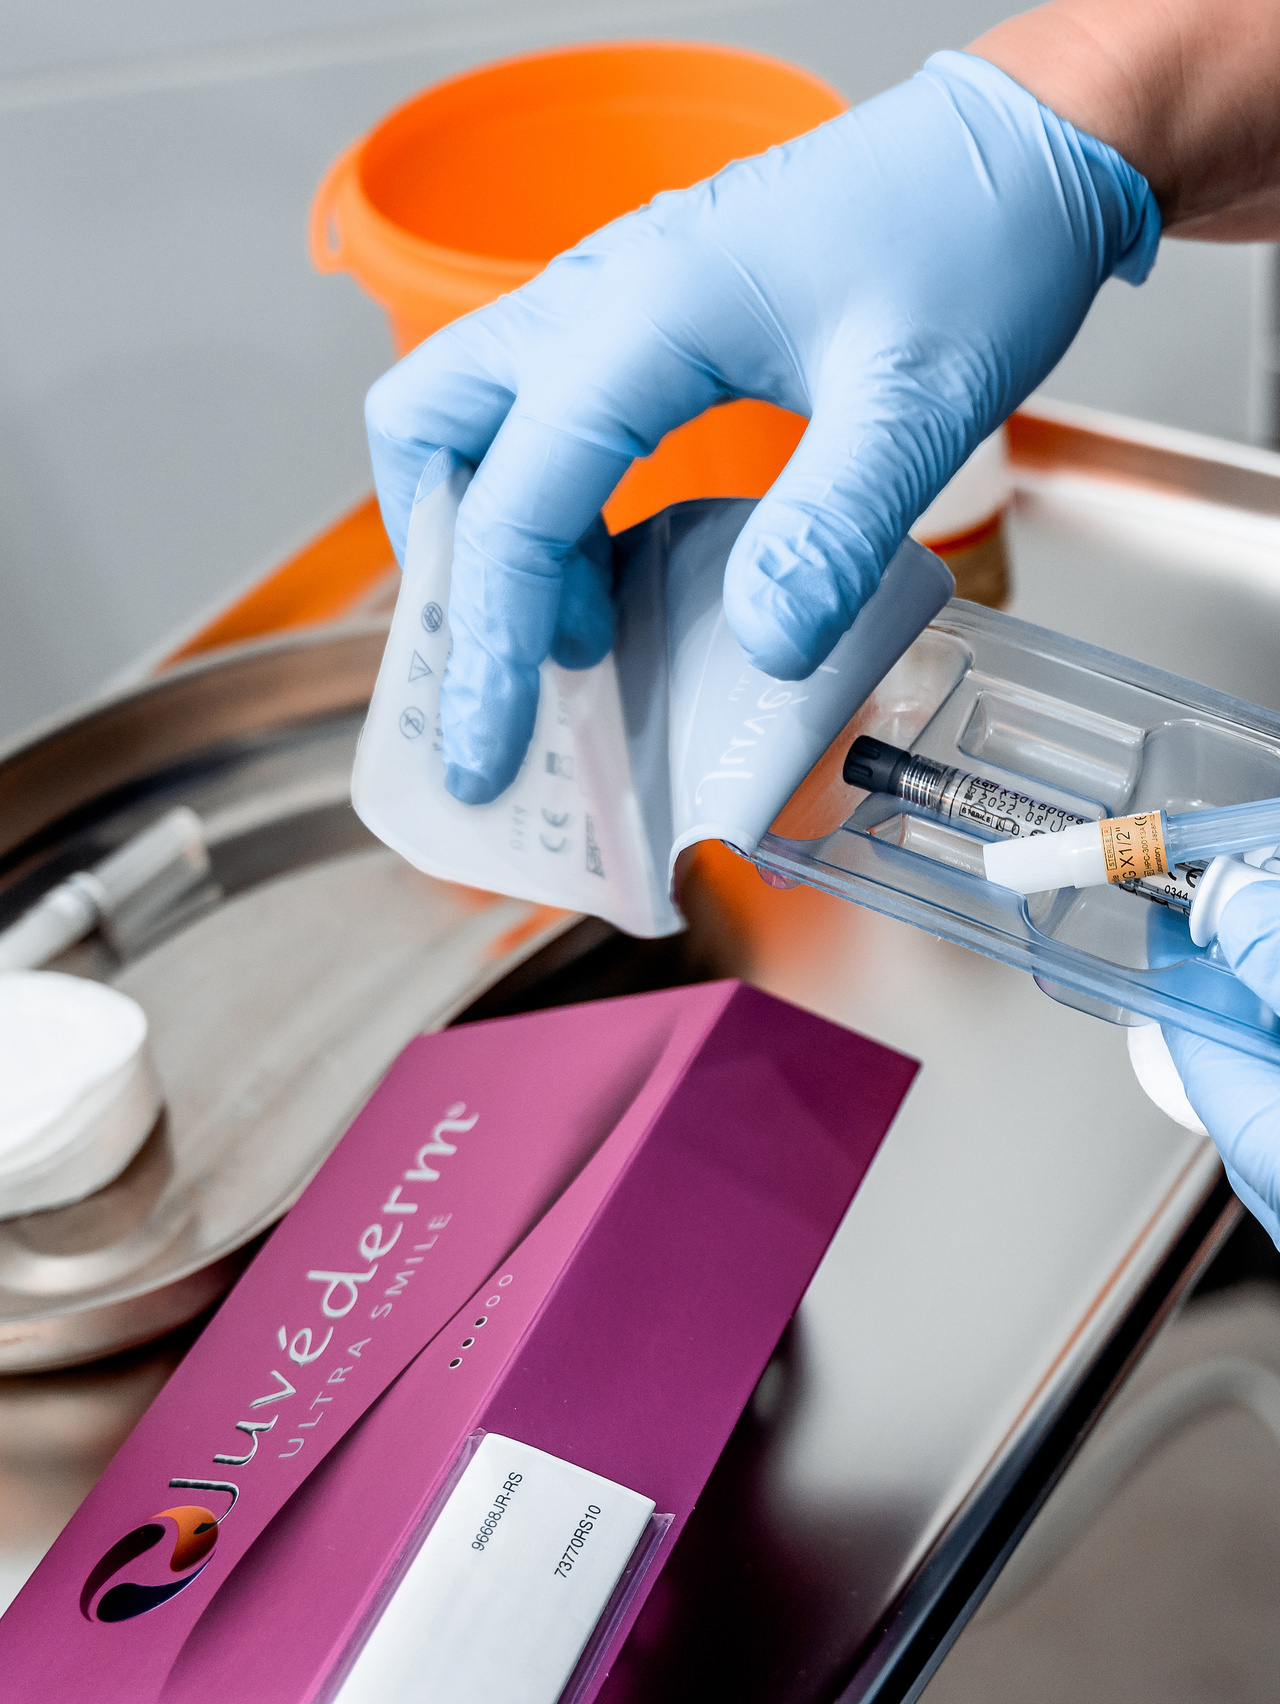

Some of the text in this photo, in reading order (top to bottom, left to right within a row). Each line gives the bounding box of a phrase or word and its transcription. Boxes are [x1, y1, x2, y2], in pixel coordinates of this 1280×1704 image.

[978, 793, 1044, 826] 2022.08
[1001, 788, 1085, 825] X30LB0066
[1164, 884, 1189, 902] 0344
[277, 1212, 453, 1459] ULTRA SMILE
[471, 1471, 523, 1551] 96668JR-RS
[553, 1504, 602, 1579] 73770RS10
